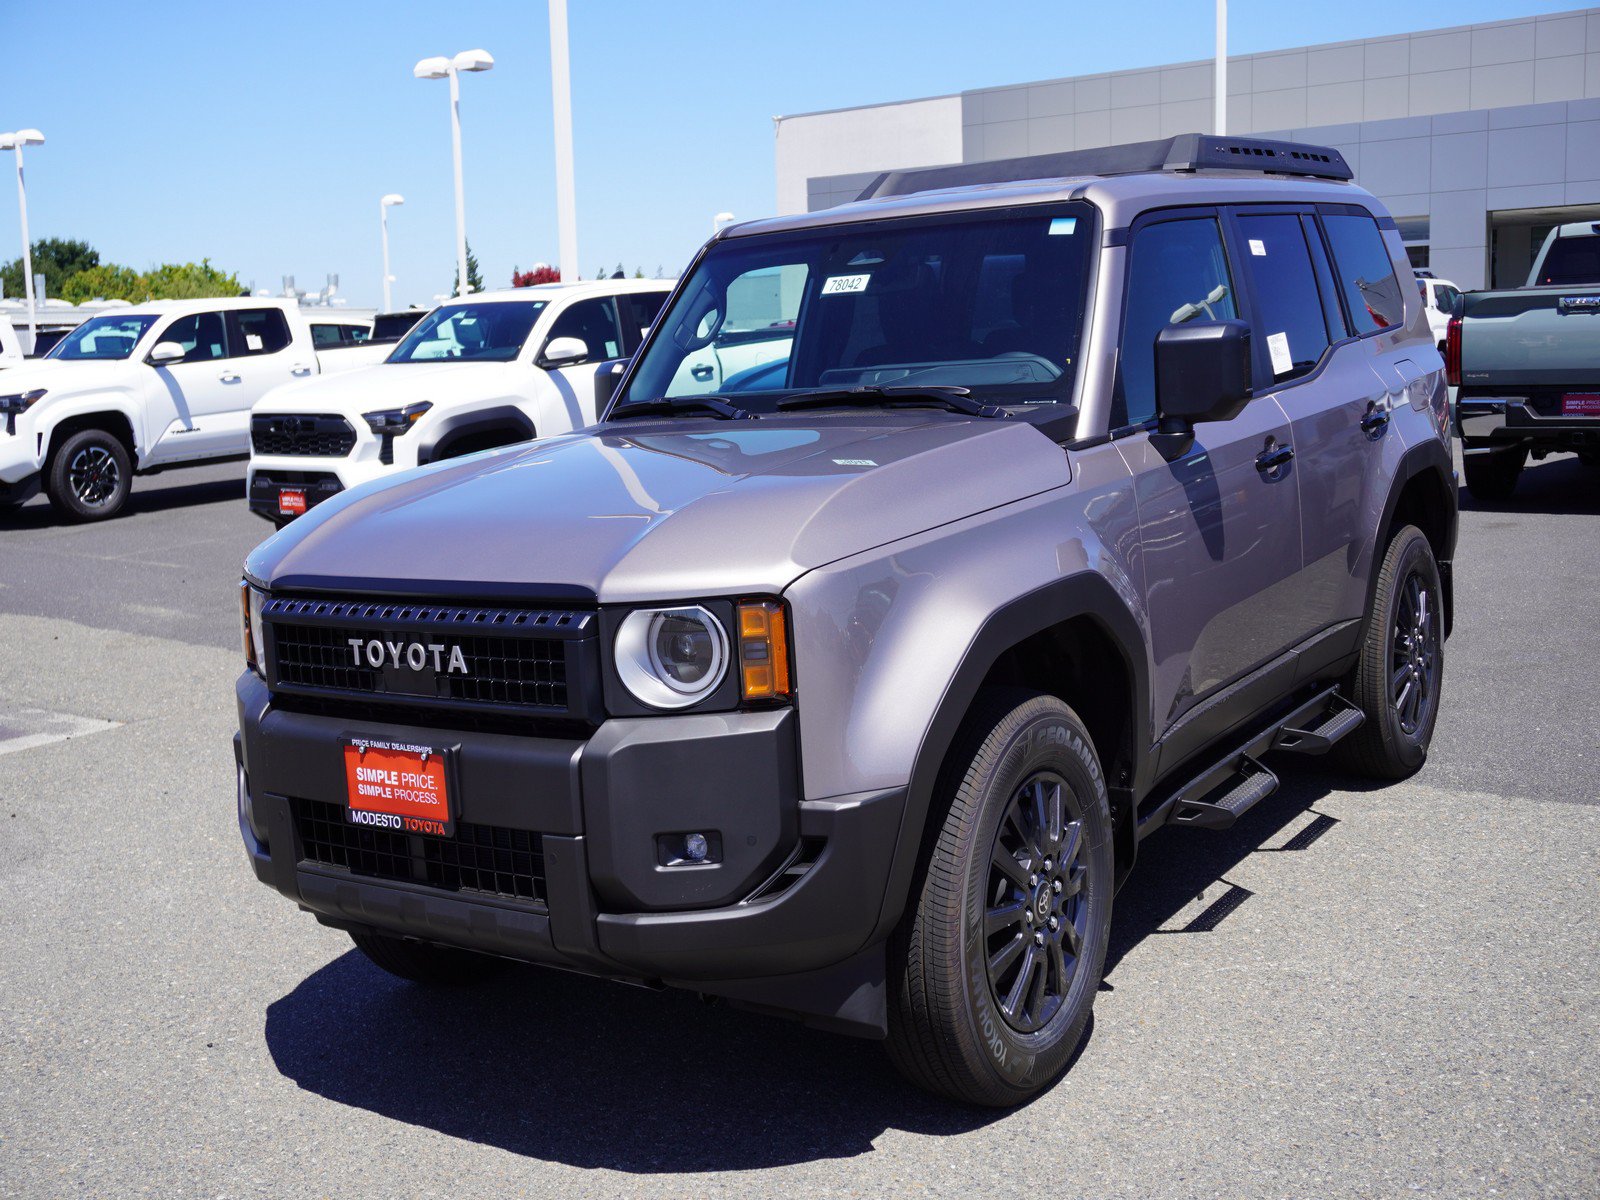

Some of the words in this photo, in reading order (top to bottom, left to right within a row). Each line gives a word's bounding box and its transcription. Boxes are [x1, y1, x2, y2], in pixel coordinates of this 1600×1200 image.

[829, 277, 862, 291] 78042
[348, 638, 468, 674] TOYOTA
[351, 739, 370, 748] PRICE
[370, 740, 391, 750] FAMILY
[391, 742, 433, 754] DEALERSHIPS
[356, 767, 399, 786] SIMPLE
[401, 772, 438, 790] PRICE.
[1036, 725, 1110, 818] GEOLANDAR
[357, 784, 393, 799] SIMPLE
[394, 788, 440, 805] PROCESS.
[352, 810, 402, 829] MODESTO
[404, 817, 446, 836] TOYOTA
